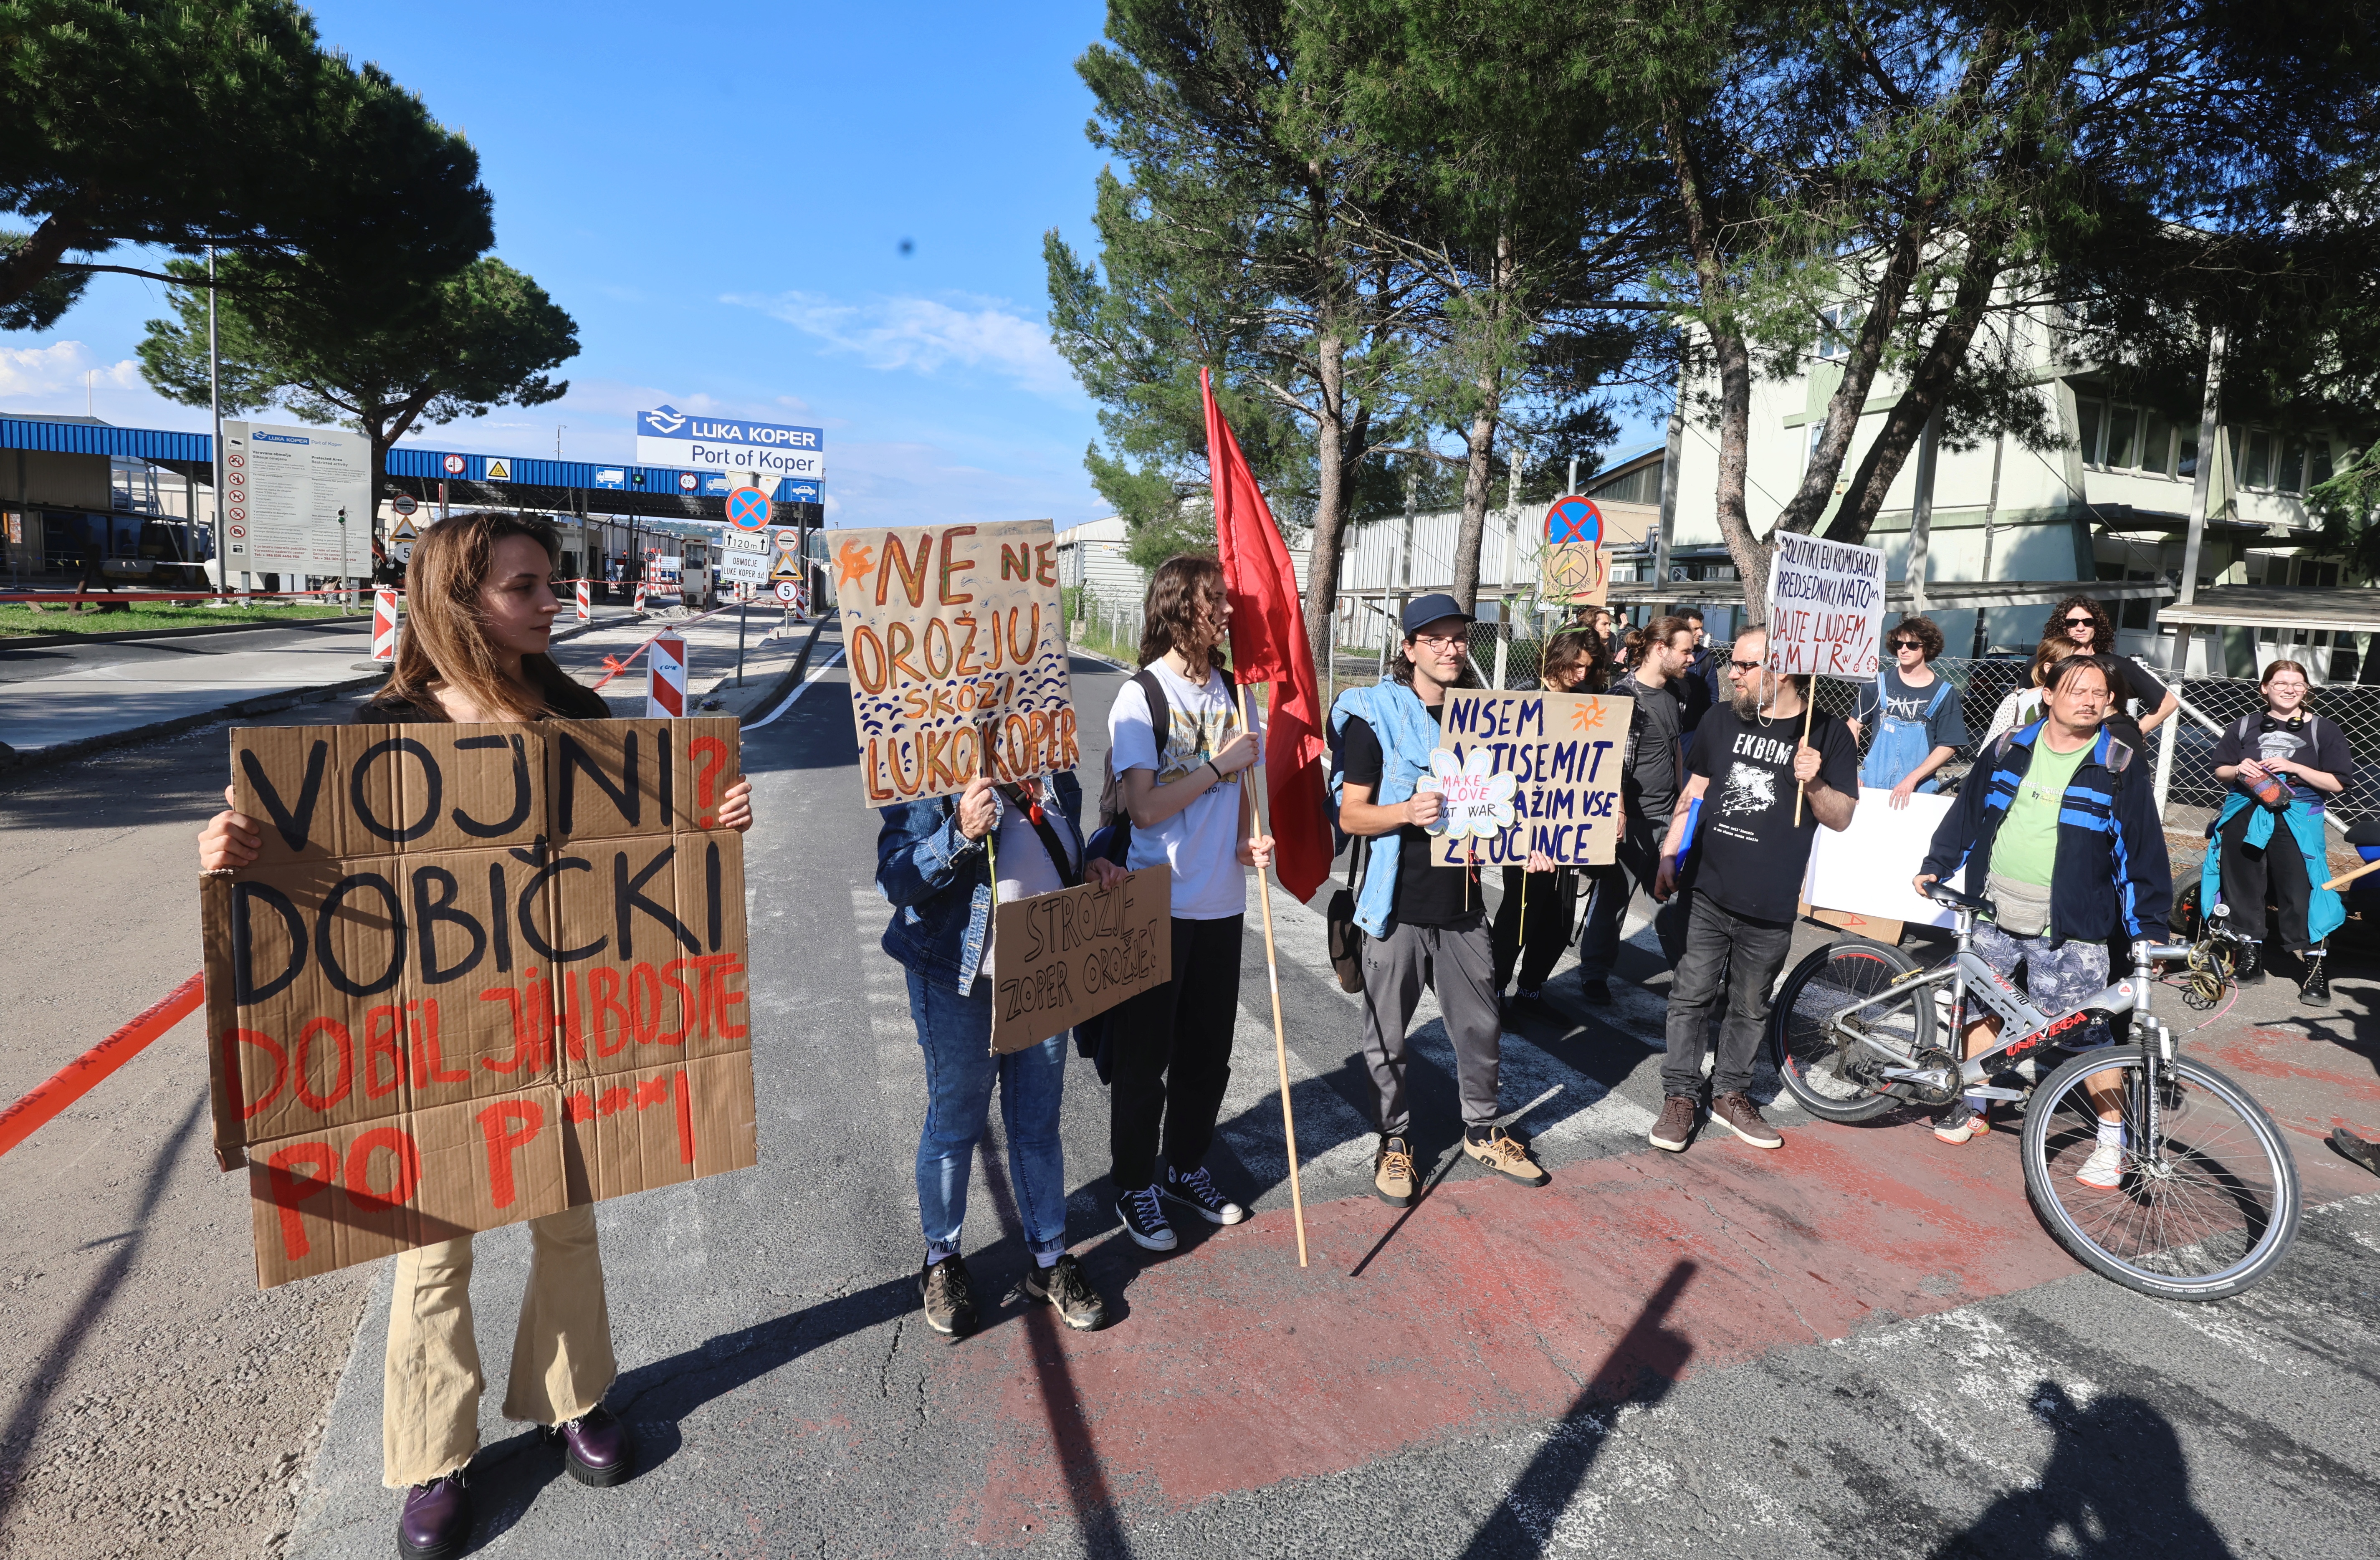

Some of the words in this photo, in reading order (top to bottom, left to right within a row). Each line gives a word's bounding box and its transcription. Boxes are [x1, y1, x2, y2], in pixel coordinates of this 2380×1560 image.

[692, 422, 743, 440] LUKA
[749, 427, 815, 447] KOPER
[692, 445, 730, 464] Port
[735, 450, 753, 466] of
[759, 451, 814, 473] Koper
[404, 548, 410, 558] 5
[733, 557, 757, 567] OBMOČJE
[1576, 543, 1591, 555] PACE
[1781, 536, 1819, 574] POLITIKI,
[1821, 545, 1832, 571] EU
[1833, 549, 1879, 582] KOMISARJI,
[724, 567, 736, 575] LUKE
[739, 569, 755, 577] KOPER
[875, 526, 977, 608] NE
[1001, 541, 1057, 588] NE
[784, 586, 790, 597] 5
[1777, 571, 1837, 609] PREDSEDNIKI,
[1773, 607, 1810, 643] DAJTE
[1814, 612, 1866, 647] LJUDEM
[852, 602, 1039, 695] OROŽJU
[904, 676, 1014, 719] SKOZI
[1448, 697, 1543, 738] NISEM
[868, 726, 979, 800] LUKO
[982, 708, 1080, 782] KOPER
[1733, 733, 1793, 766] EKBOM
[1442, 775, 1482, 789] MAKE
[1446, 788, 1490, 802] LOVE
[1469, 804, 1497, 818] WAR
[1583, 790, 1618, 817] VSE
[232, 834, 722, 1005] DOBIČKI
[1000, 961, 1073, 1022] ZOPER
[1083, 918, 1157, 994] OROŽJE!
[2006, 1012, 2087, 1056] UNIVEGA
[268, 1126, 421, 1262] PO
